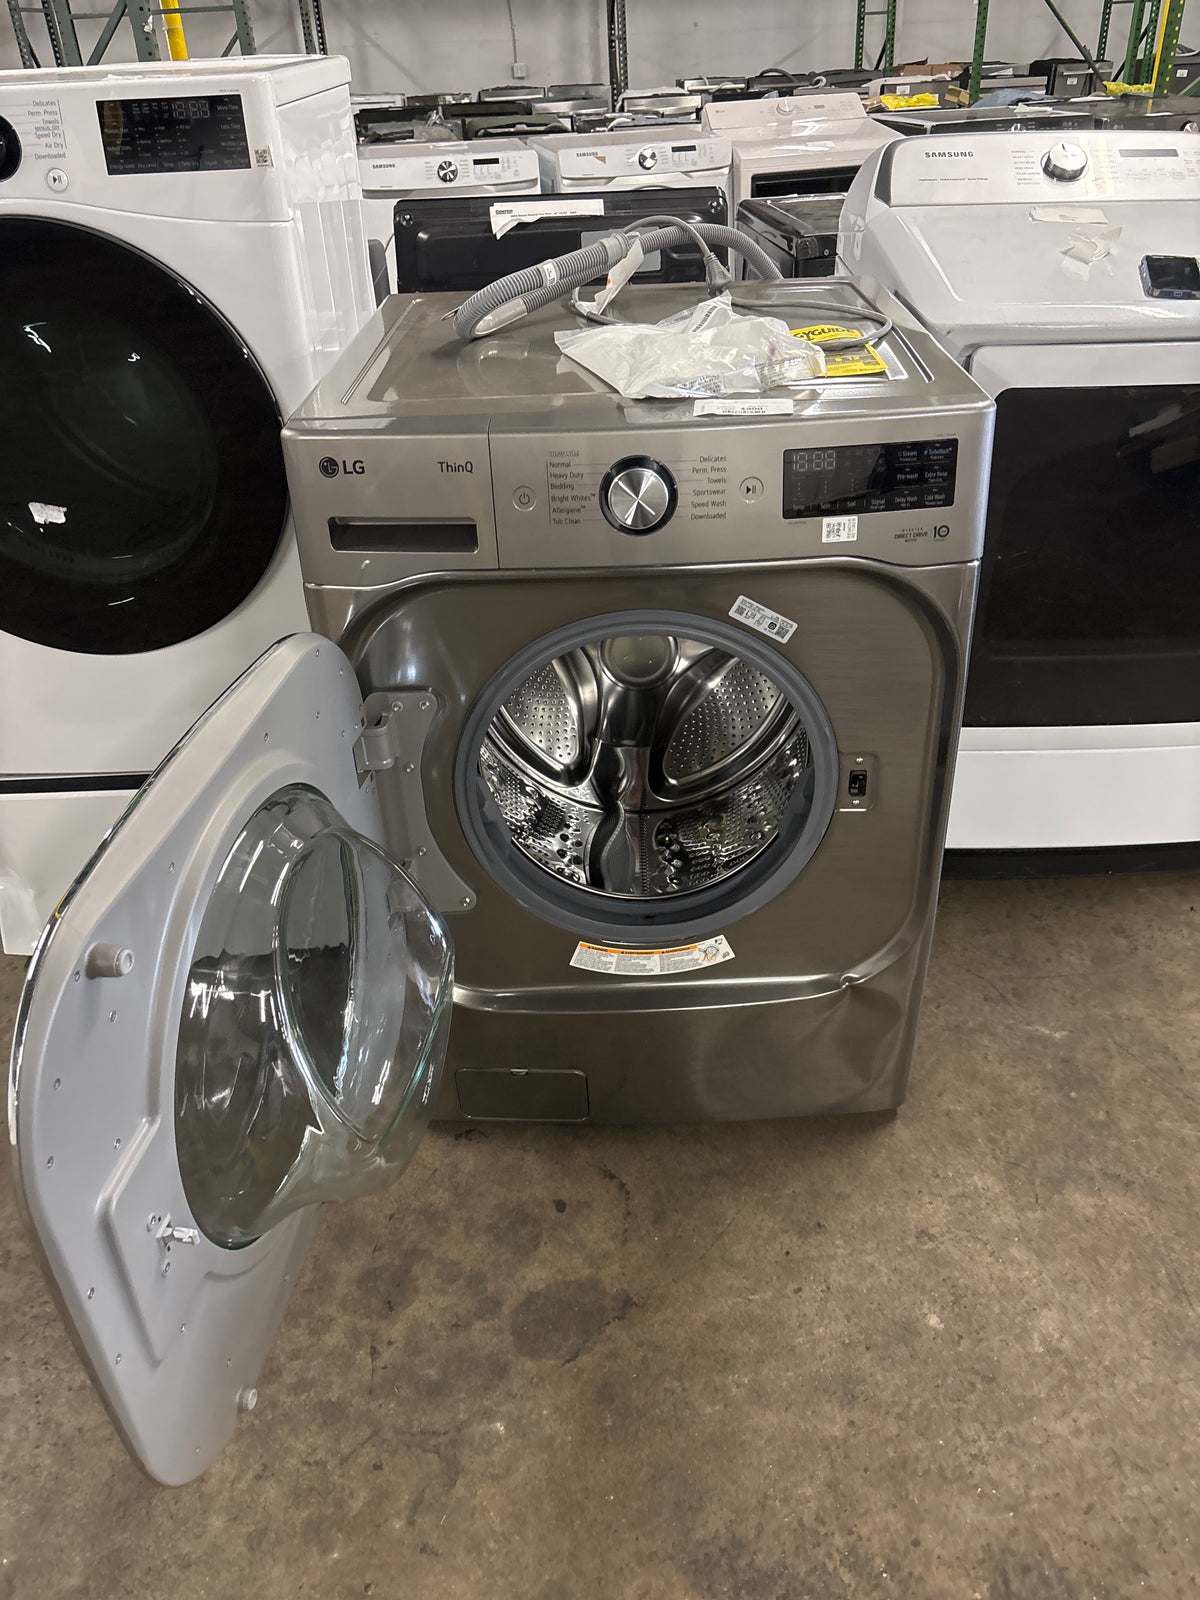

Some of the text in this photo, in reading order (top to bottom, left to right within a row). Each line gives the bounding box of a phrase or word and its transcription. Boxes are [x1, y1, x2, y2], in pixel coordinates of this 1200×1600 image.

[52, 131, 62, 139] Dry
[35, 152, 66, 160] Downloaded
[700, 455, 727, 463] Delicates
[343, 460, 365, 475] LG
[437, 461, 474, 473] ThinQ
[710, 465, 727, 473] Press
[550, 472, 584, 480] Heavy Duty
[692, 488, 727, 497] Sportswear
[551, 495, 569, 503] Bright
[691, 501, 709, 509] Speed
[691, 512, 727, 520] Downloaded
[933, 525, 950, 538] 10
